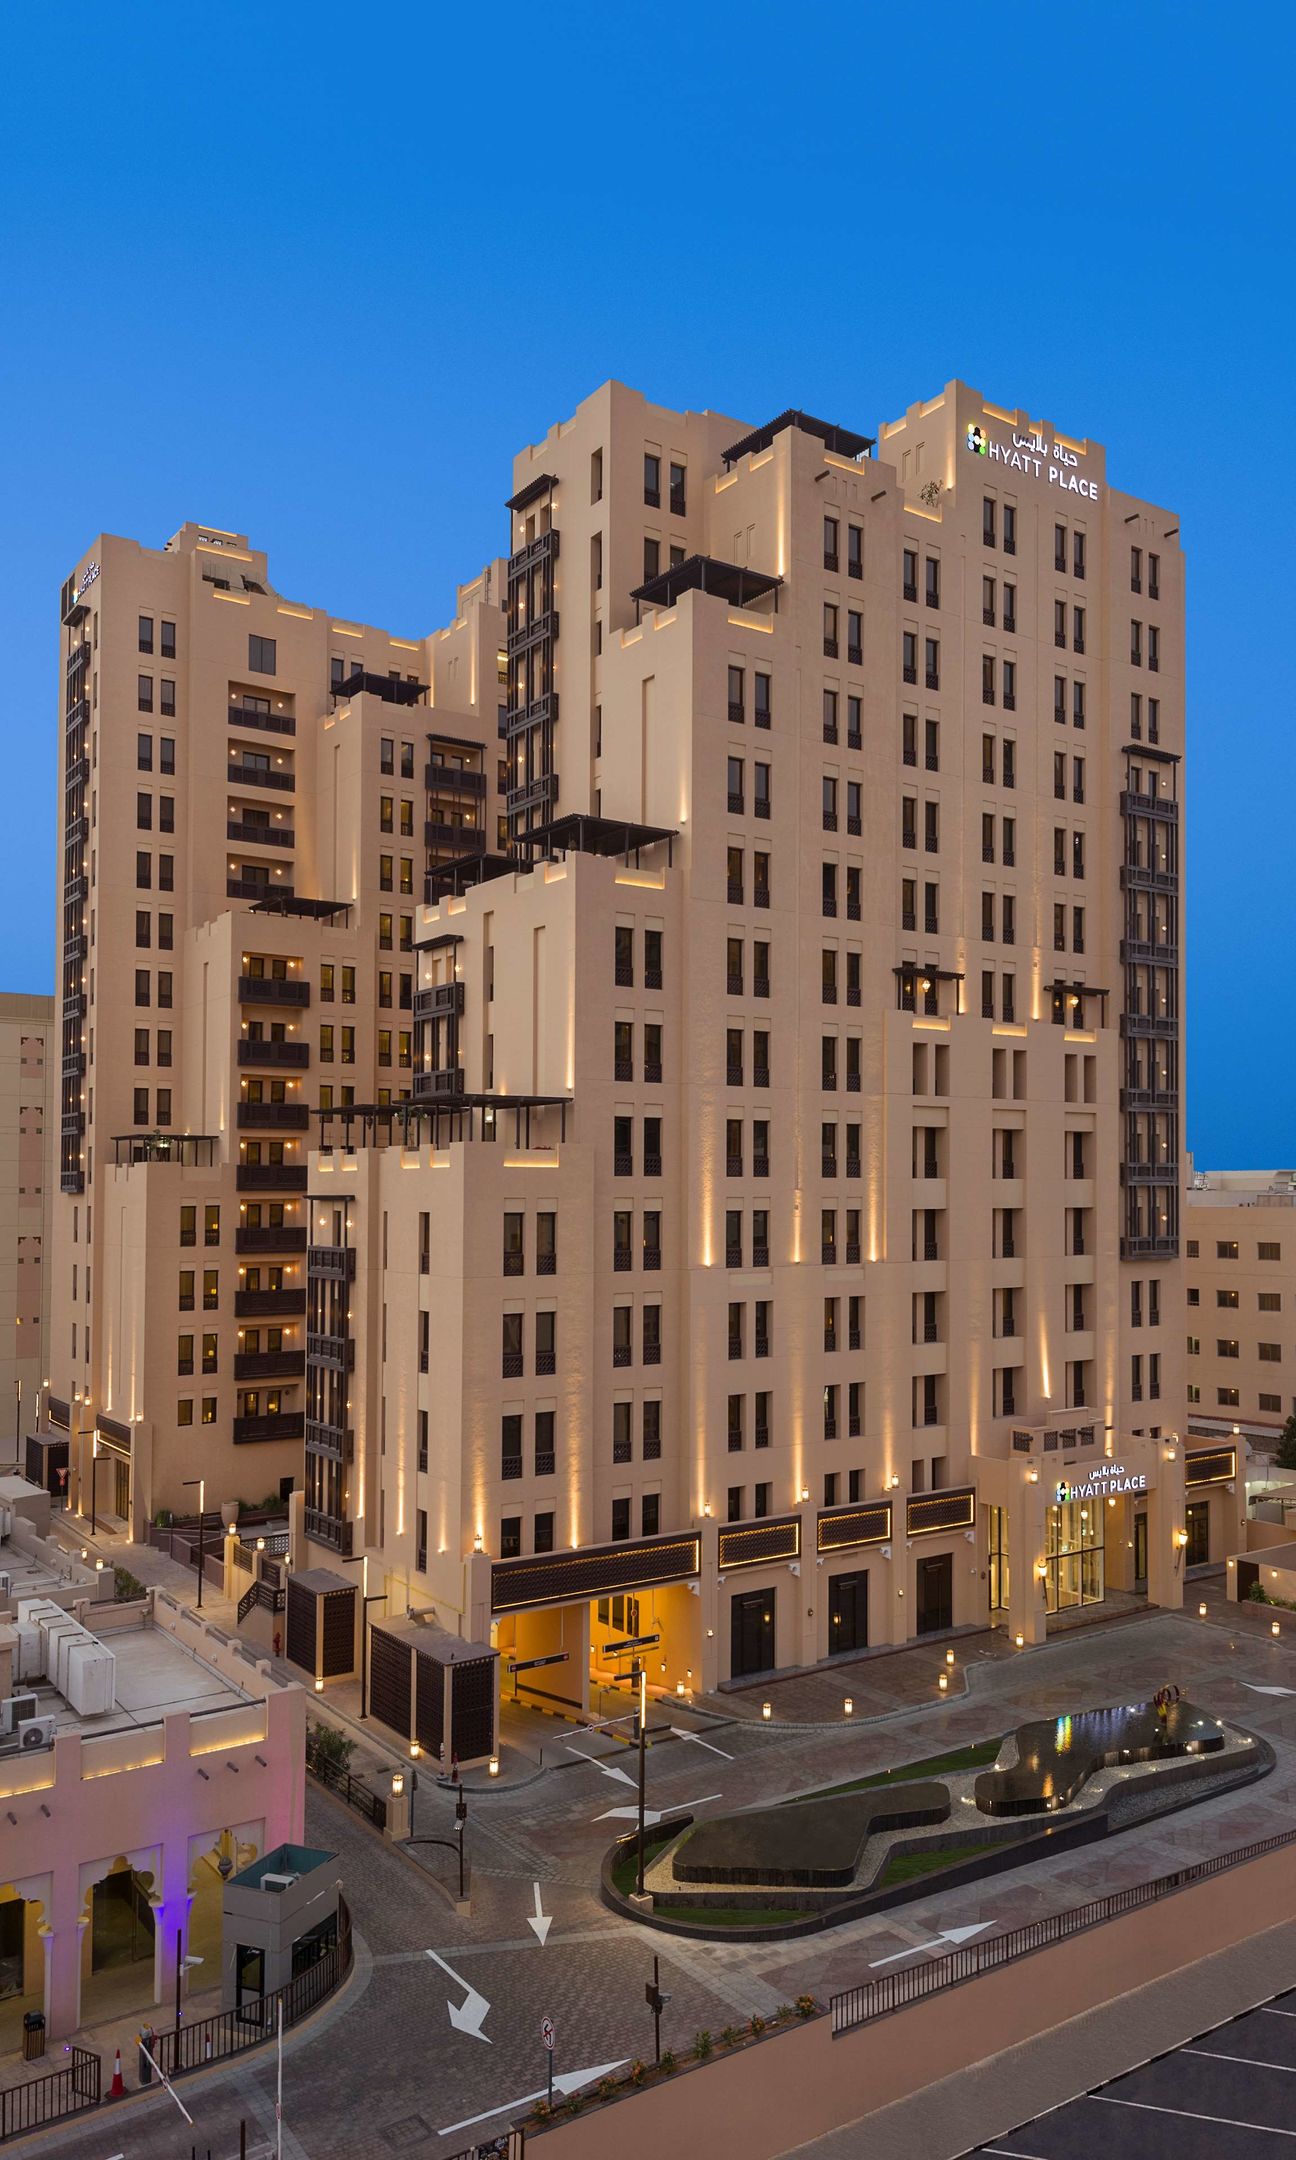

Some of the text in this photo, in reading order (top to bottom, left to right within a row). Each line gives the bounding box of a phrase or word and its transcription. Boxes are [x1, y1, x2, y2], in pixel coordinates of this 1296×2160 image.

[1012, 433, 1078, 467] حياة بلايس
[988, 441, 1098, 501] HYATT PLACE
[1070, 1475, 1146, 1499] HYATT PLACE
